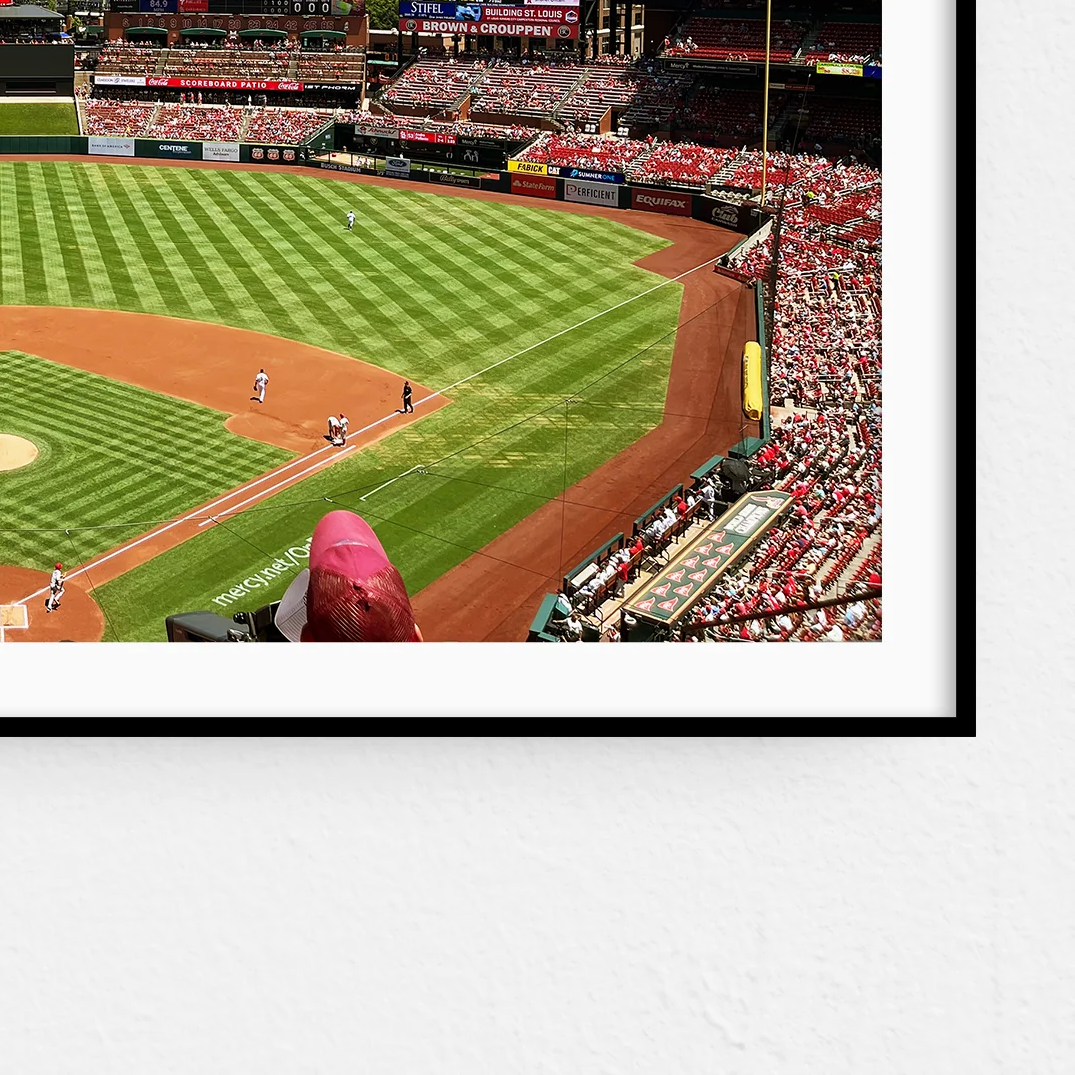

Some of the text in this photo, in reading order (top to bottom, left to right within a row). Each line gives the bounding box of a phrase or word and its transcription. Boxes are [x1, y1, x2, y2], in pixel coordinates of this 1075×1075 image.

[149, 0, 168, 8] 84.9
[294, 2, 329, 13] 0 0 0
[411, 2, 443, 14] STIFEL
[485, 8, 563, 18] BUILDING ST. LOUIS
[170, 18, 177, 28] 9
[182, 18, 192, 28] 10
[285, 20, 298, 30] 42
[422, 21, 552, 36] BROWN & CROUPPEN
[148, 77, 168, 86] Coca-Cola
[180, 79, 238, 88] SCOREBOARD
[277, 82, 300, 91] Coca-Cola
[321, 162, 362, 173] BUSCH STADIUM
[517, 163, 561, 175] FABICK CAT
[566, 184, 616, 200] PERFICIENT
[635, 194, 686, 209] EQUIFAX
[711, 207, 739, 223] Club
